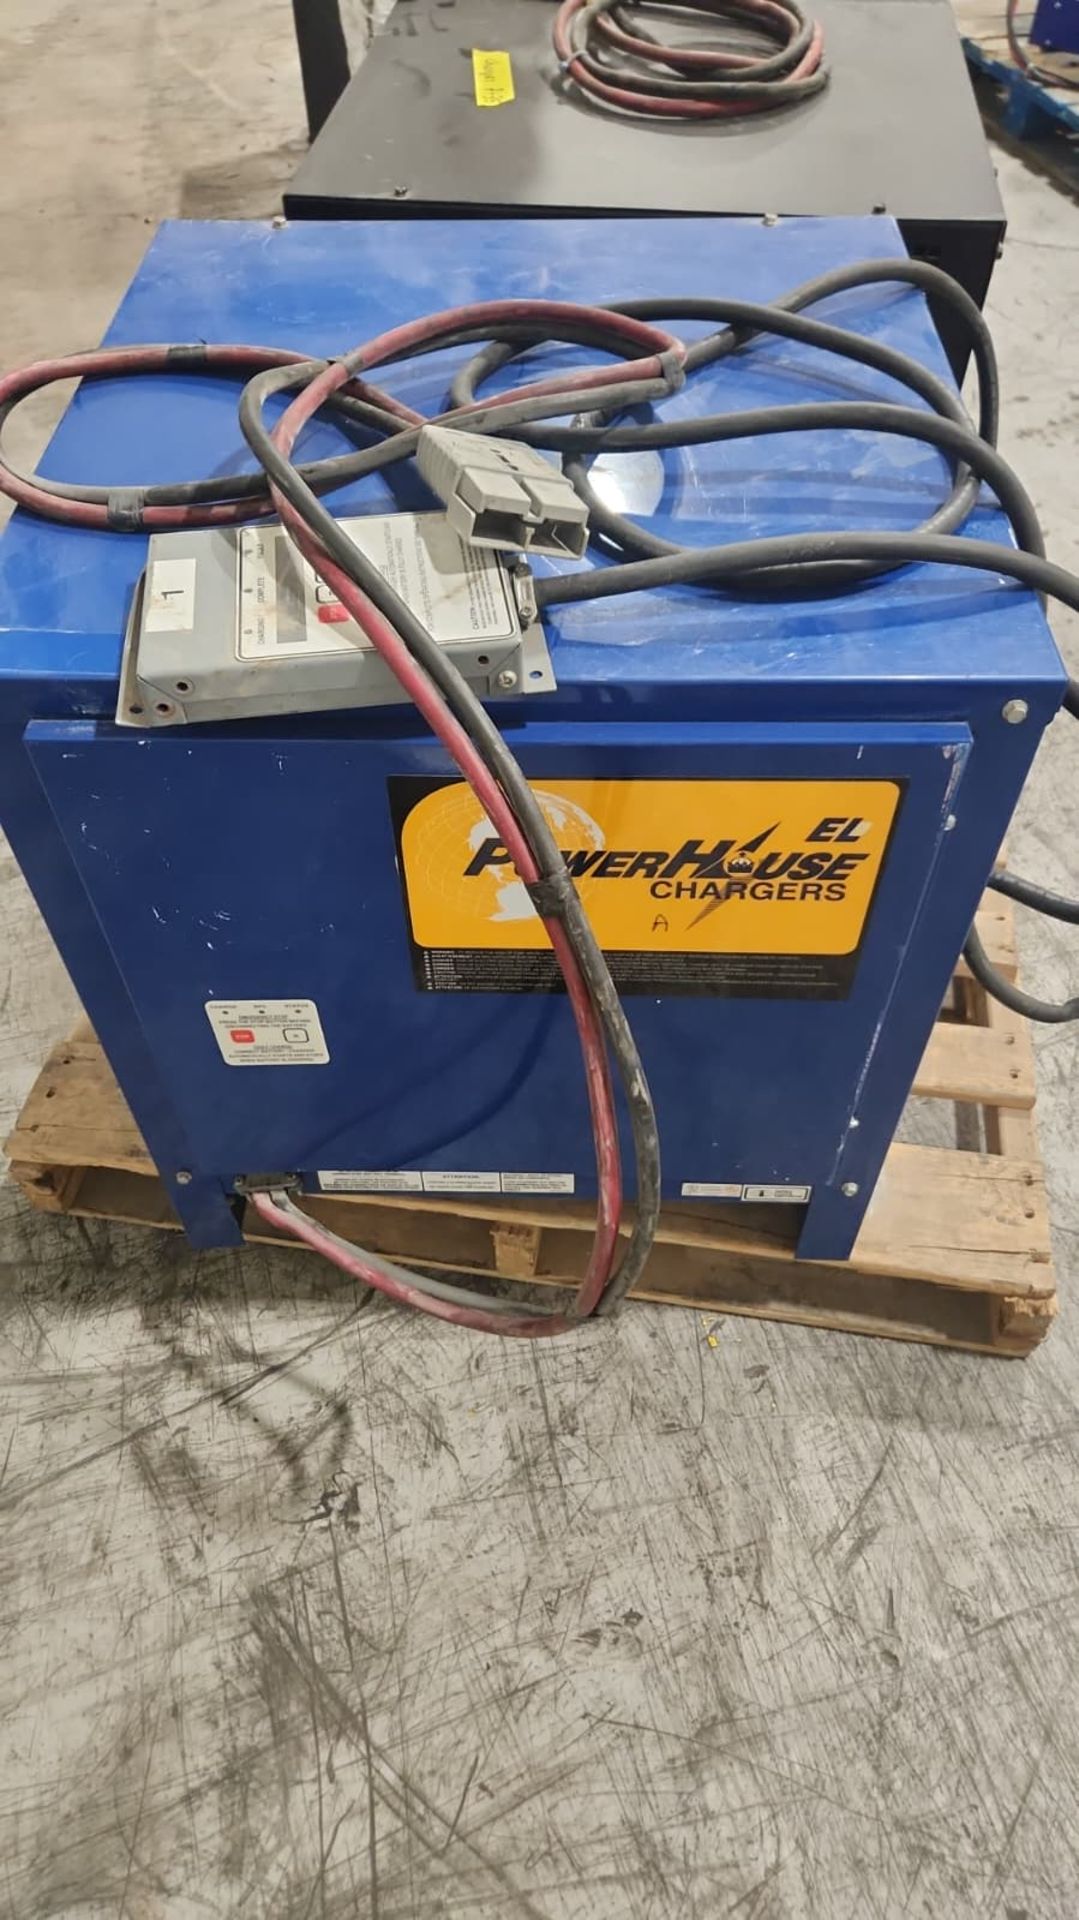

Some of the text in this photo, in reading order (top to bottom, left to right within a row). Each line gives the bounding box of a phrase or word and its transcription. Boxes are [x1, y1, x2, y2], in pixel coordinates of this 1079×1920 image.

[161, 589, 185, 601] 1
[805, 817, 865, 842] EL
[650, 881, 847, 901] CHARGERS
[652, 913, 669, 933] A
